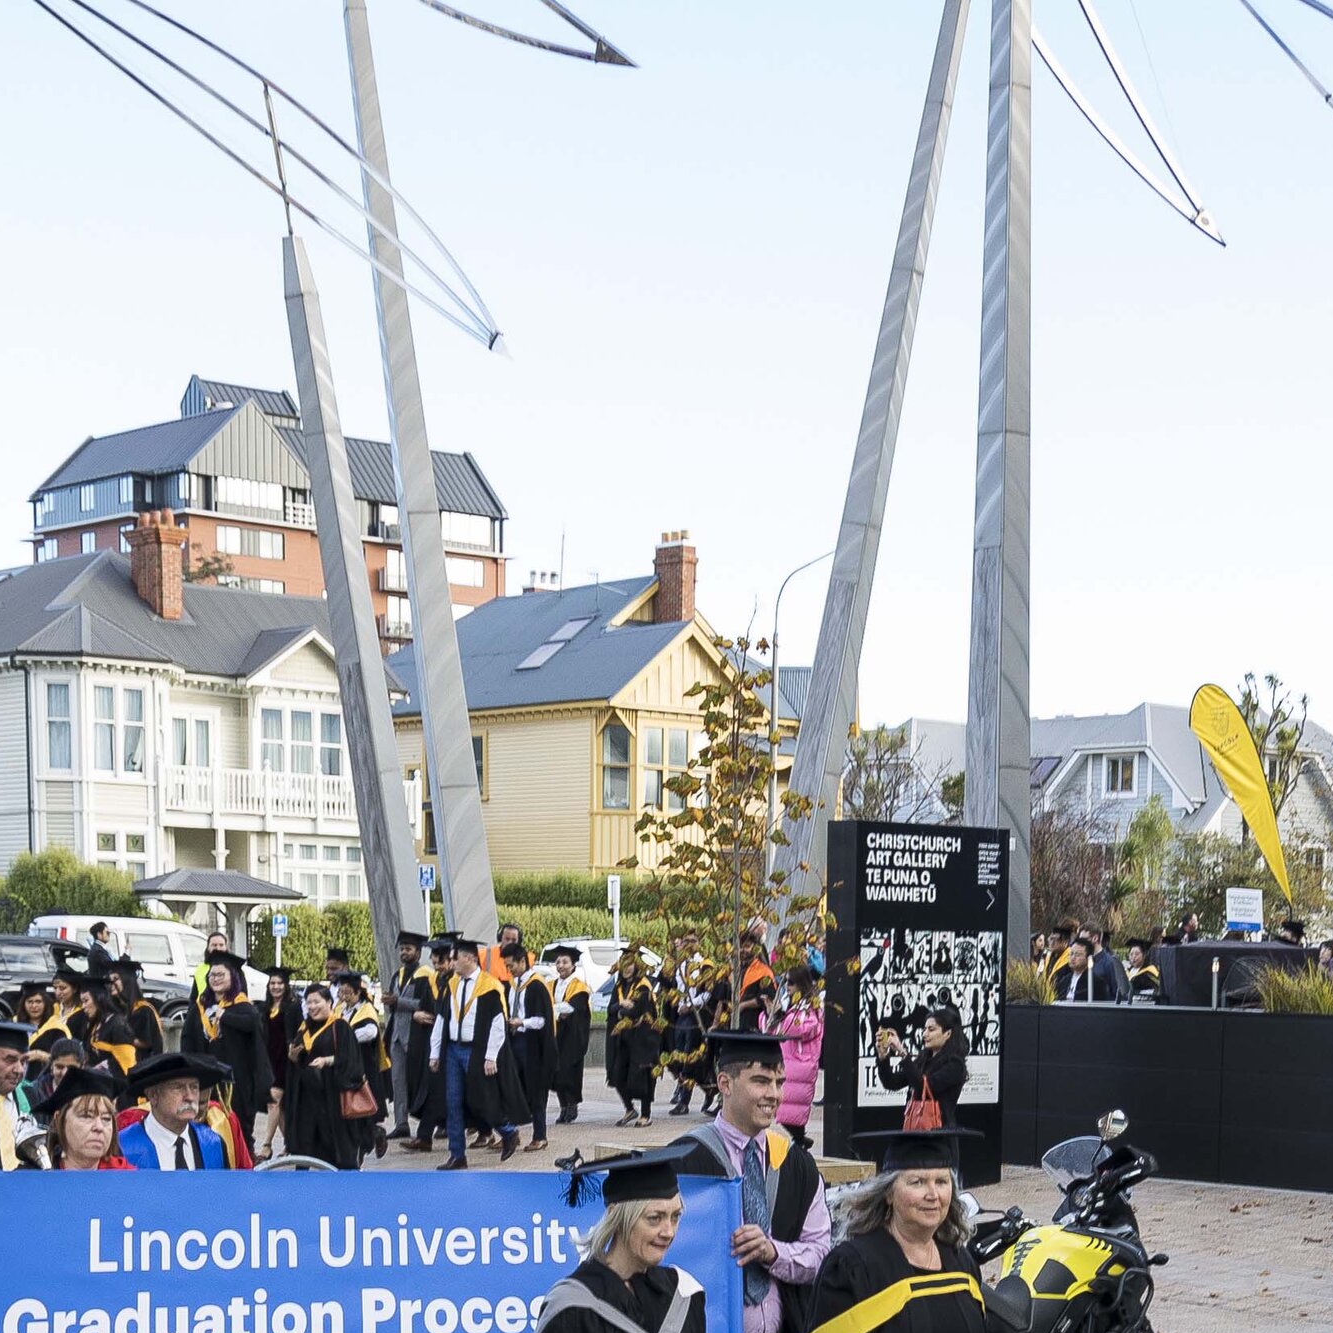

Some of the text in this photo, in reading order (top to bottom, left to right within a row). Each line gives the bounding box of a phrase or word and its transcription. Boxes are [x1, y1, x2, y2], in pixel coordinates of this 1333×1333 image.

[867, 832, 962, 853] CHRISTCHURCH
[866, 850, 948, 869] ART GALLERY
[866, 868, 931, 886] TE PUNA O
[89, 1212, 299, 1273] Lincoln
